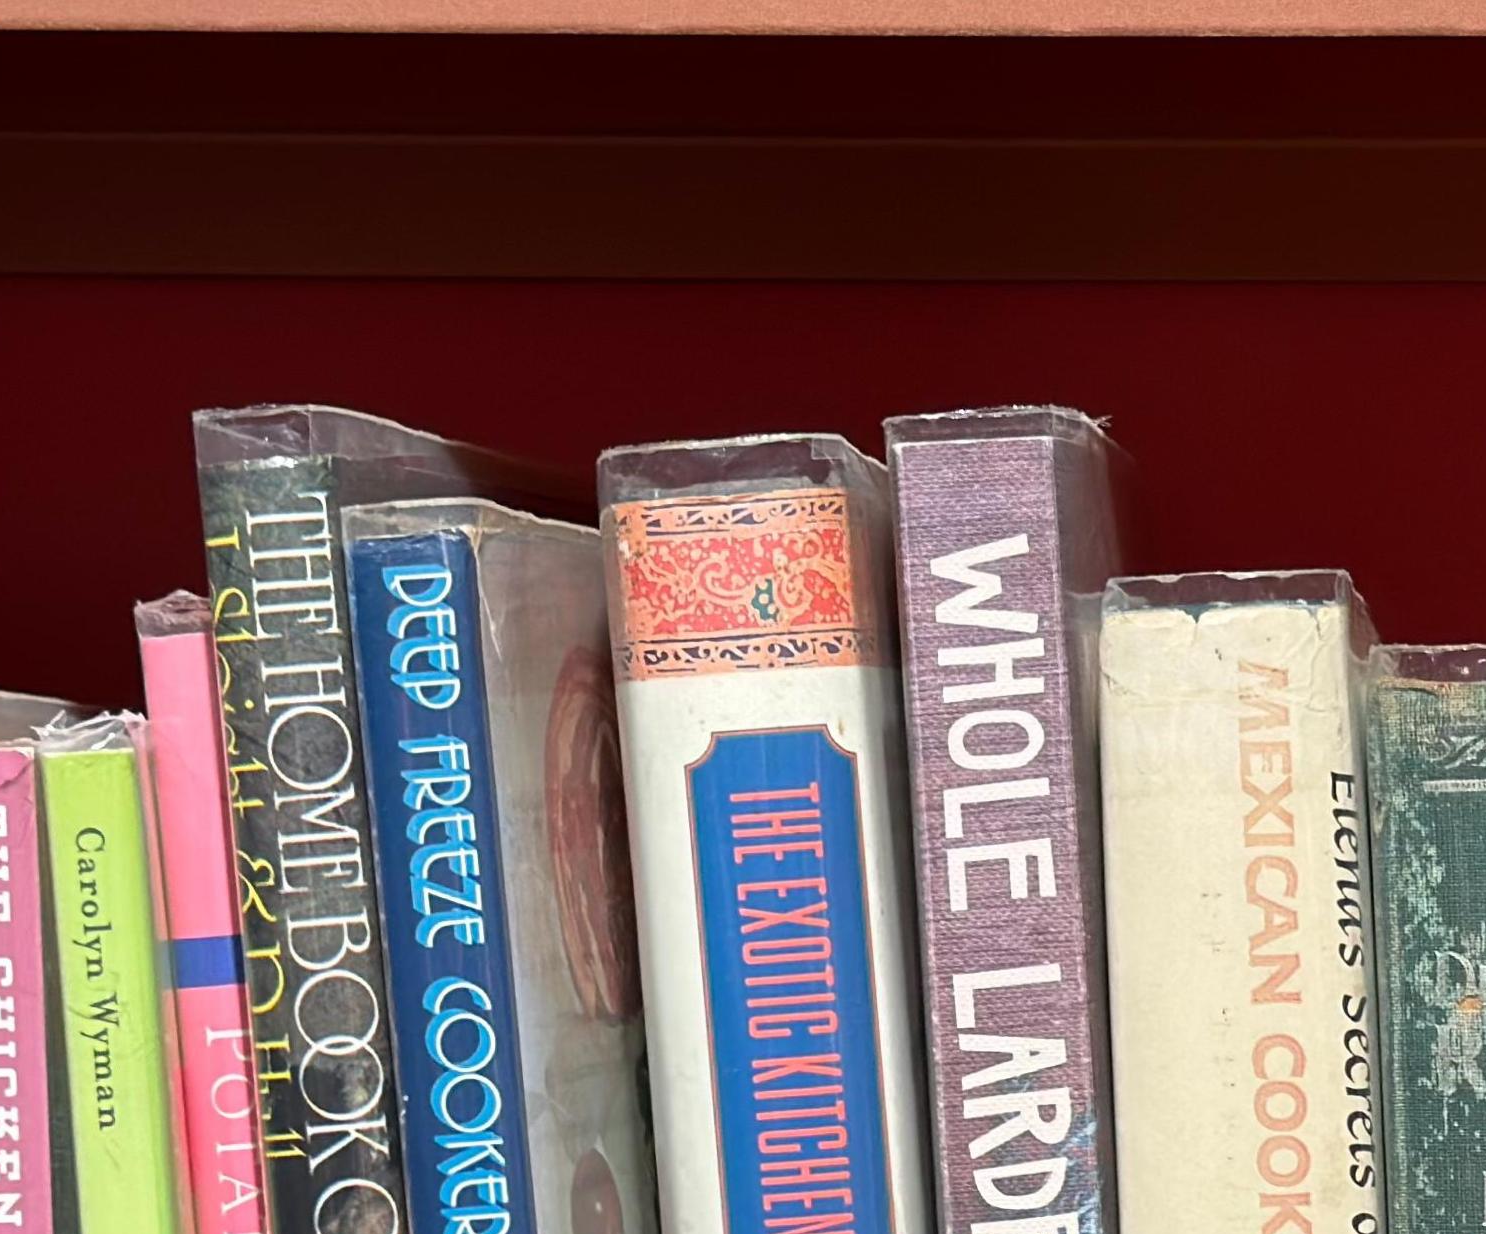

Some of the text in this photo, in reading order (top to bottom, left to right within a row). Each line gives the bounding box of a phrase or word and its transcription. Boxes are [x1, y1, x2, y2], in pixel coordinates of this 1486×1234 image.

[246, 490, 348, 641] THE
[382, 564, 463, 712] DEEP
[261, 661, 369, 895] HOME
[730, 780, 819, 864] THE
[927, 533, 1057, 914] WHOLE
[398, 732, 486, 951] FREEZE
[1237, 658, 1303, 1008] MEXICAN
[1331, 771, 1365, 967] Elenas
[72, 826, 119, 1132] Carolyn Wyman
[285, 918, 391, 1174] BOOK
[737, 880, 836, 1040] EXOTIC
[254, 1032, 307, 1158] Hll
